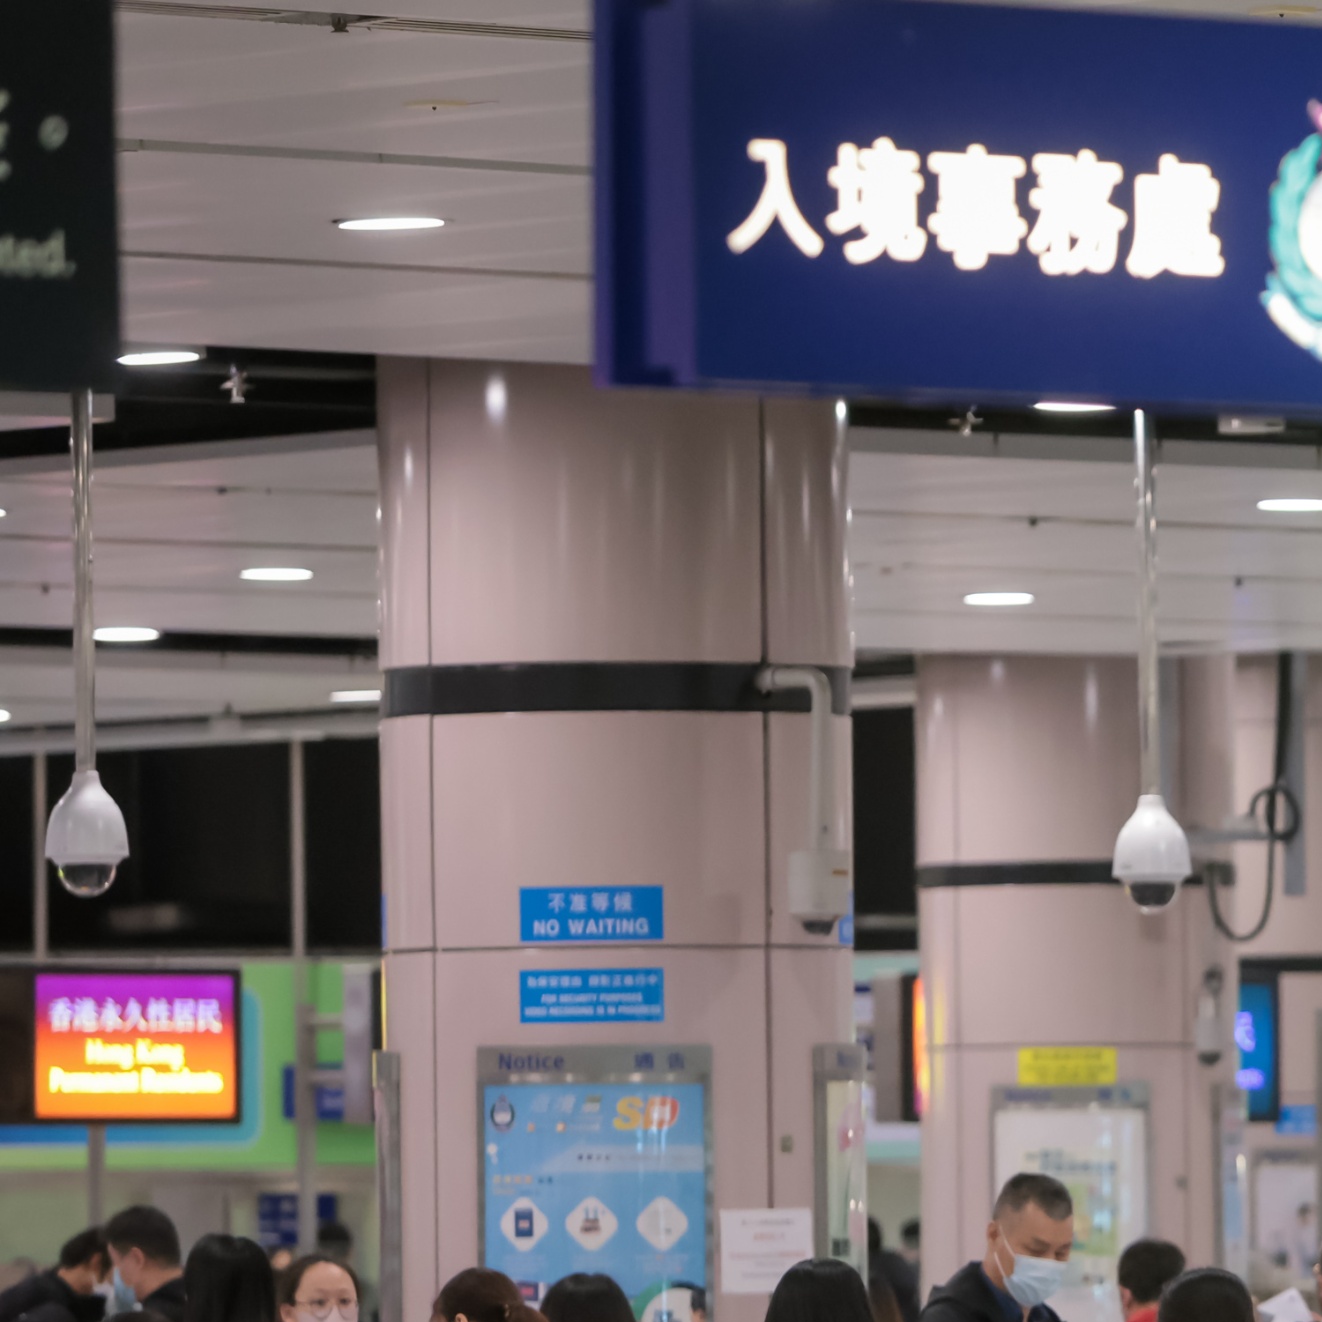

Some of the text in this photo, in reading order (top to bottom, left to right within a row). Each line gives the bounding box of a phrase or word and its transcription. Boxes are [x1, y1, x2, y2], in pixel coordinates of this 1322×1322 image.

[726, 138, 1225, 277] 入境事務處
[533, 917, 649, 936] NO WAITING
[498, 1052, 566, 1071] Notice
